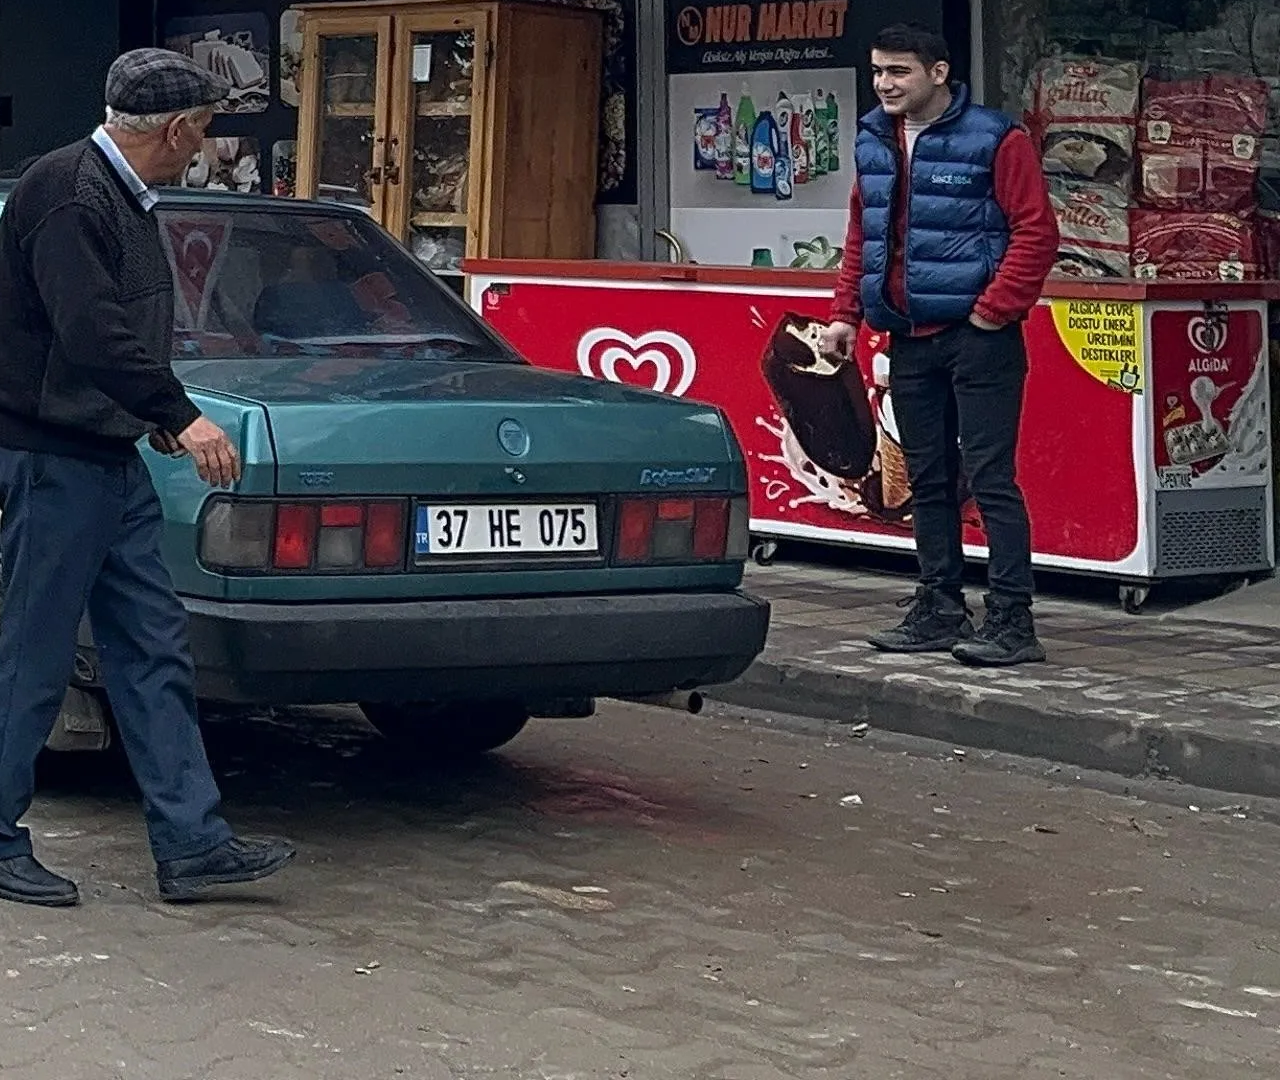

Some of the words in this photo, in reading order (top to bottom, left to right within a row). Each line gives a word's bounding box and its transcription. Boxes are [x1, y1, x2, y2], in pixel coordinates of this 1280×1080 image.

[705, 4, 752, 43] NUR
[1069, 317, 1100, 330] DOSTU
[416, 534, 428, 544] TR
[437, 510, 468, 547] 37
[490, 509, 520, 546] HE
[540, 508, 586, 546] 075
